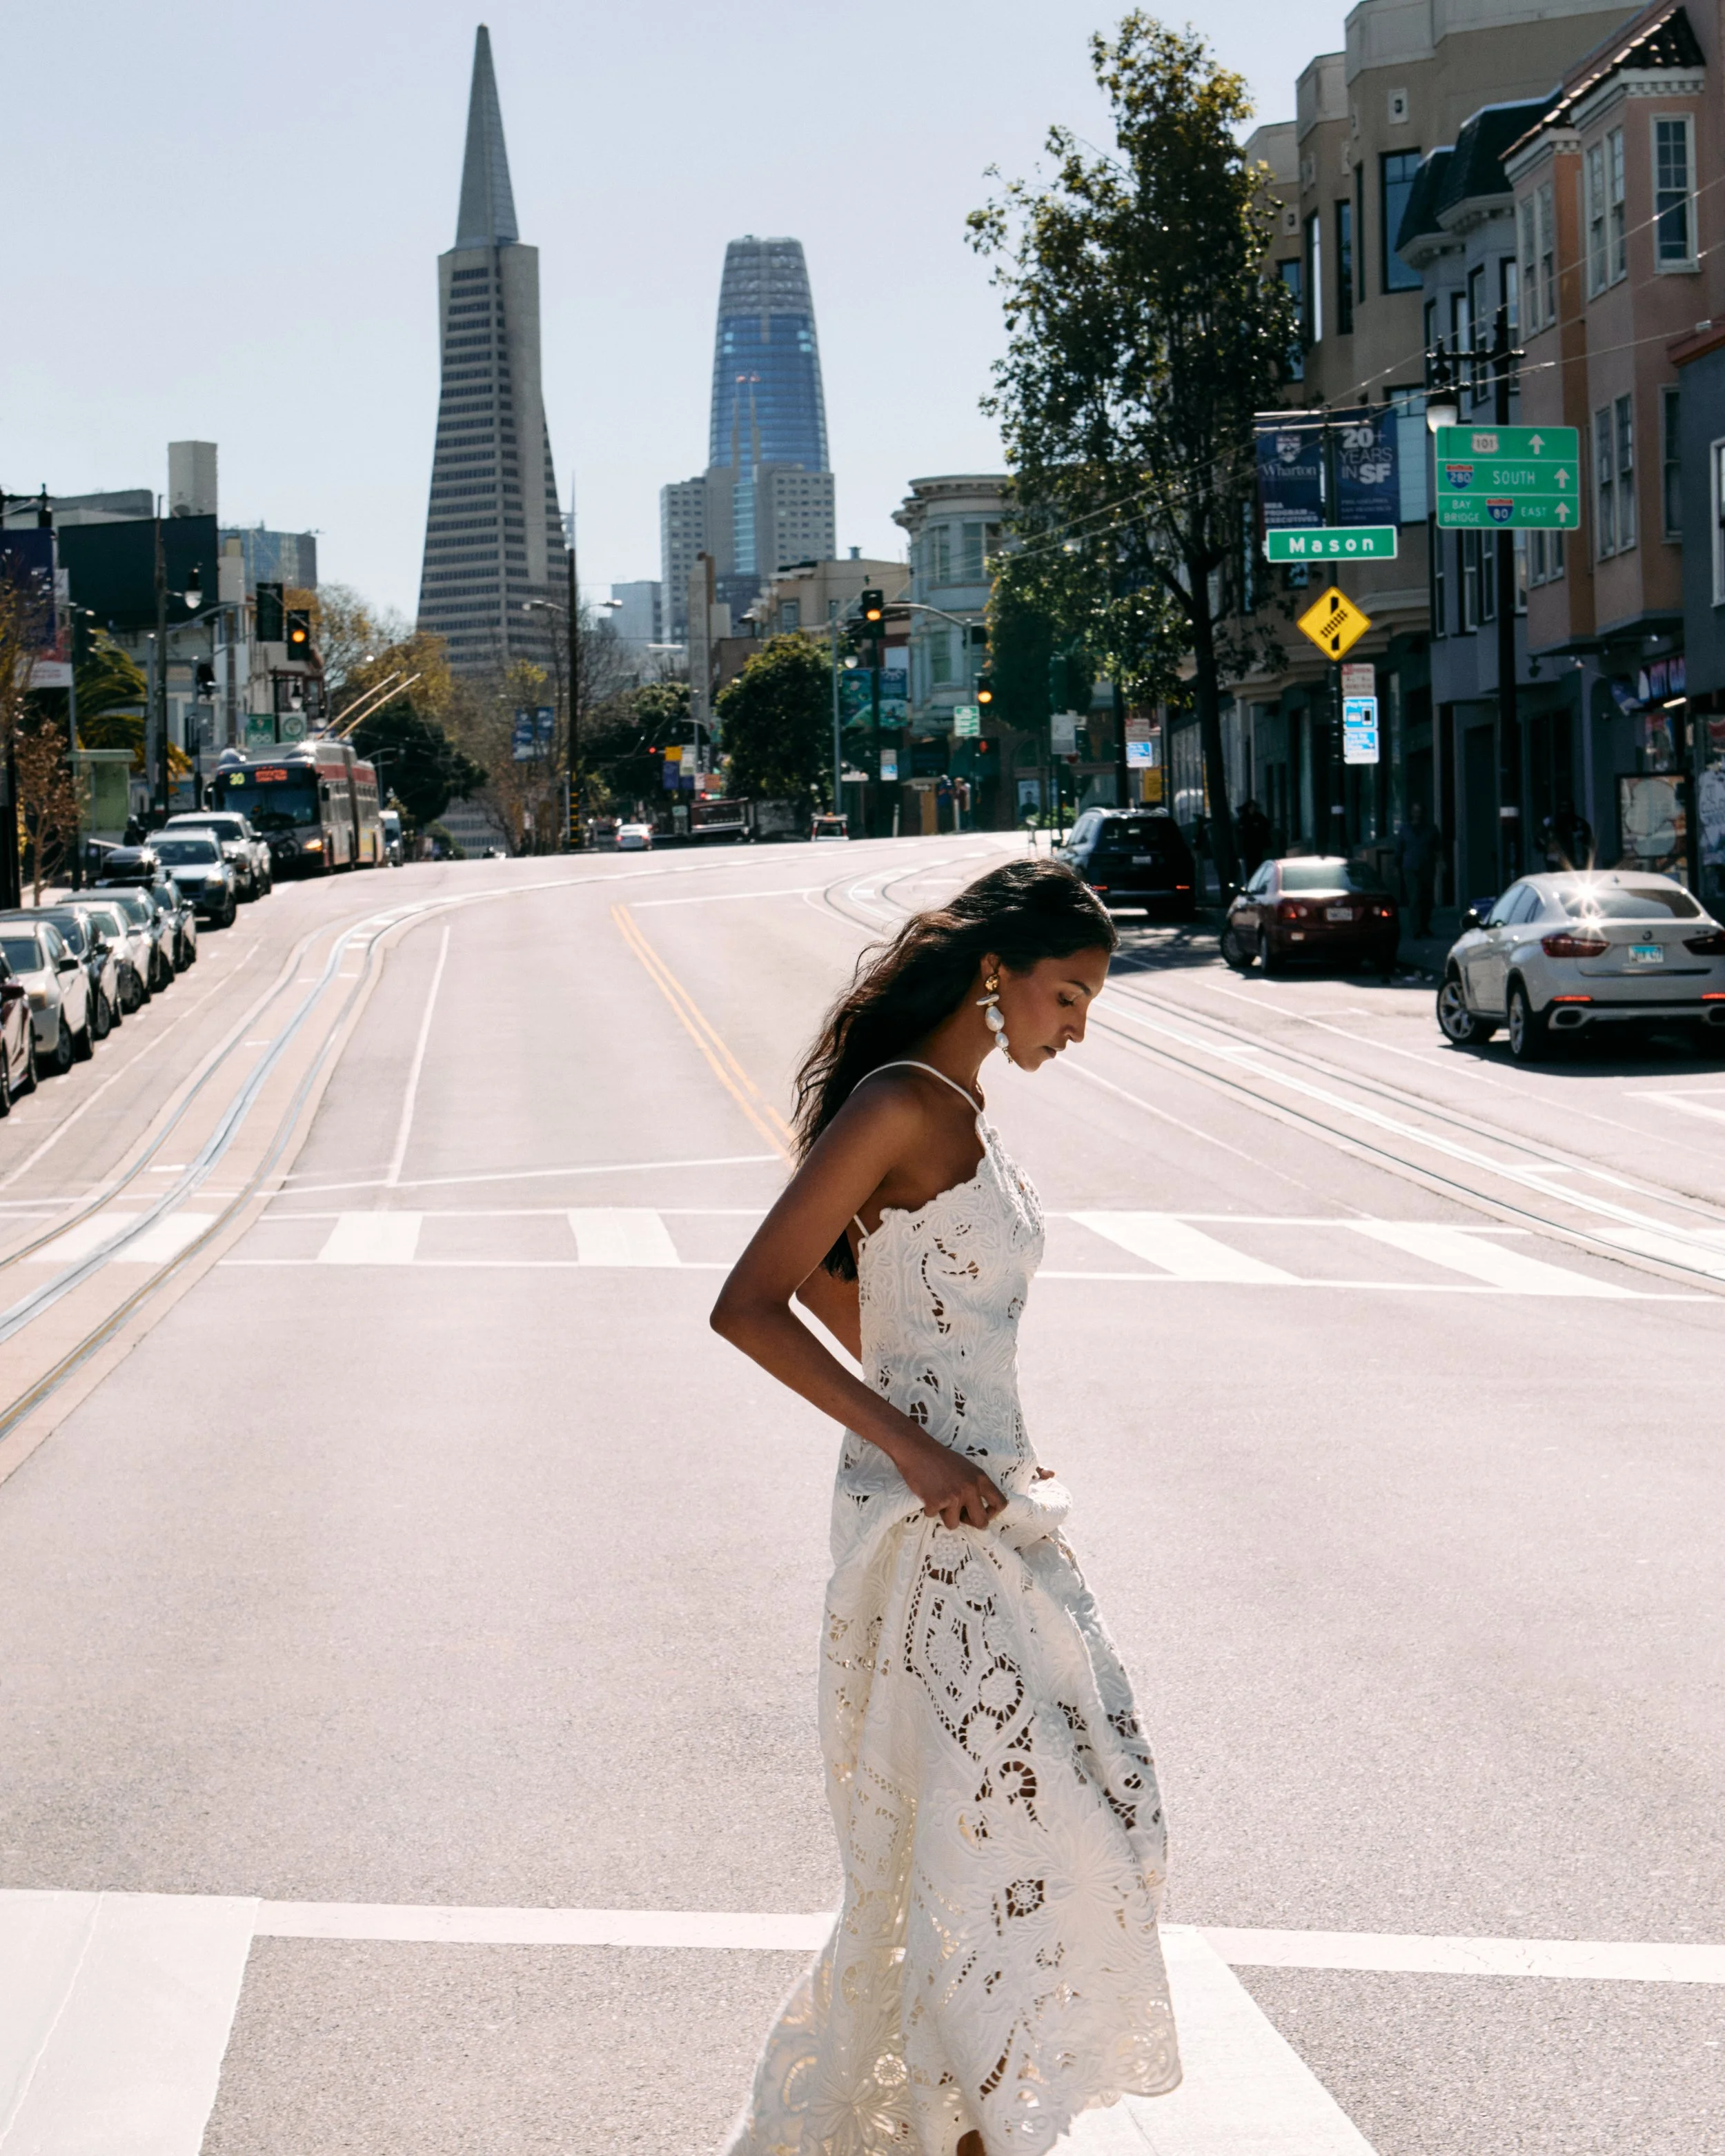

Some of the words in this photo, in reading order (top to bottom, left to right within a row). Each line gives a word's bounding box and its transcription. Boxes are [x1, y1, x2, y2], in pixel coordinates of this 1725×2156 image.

[1475, 438, 1495, 449] 101
[1339, 446, 1393, 464] YEARS
[1262, 463, 1317, 477] Wharton
[1341, 464, 1358, 479] IN
[1359, 463, 1391, 484] SF
[1450, 472, 1472, 484] 280
[1492, 471, 1535, 485] SOUTH
[1452, 499, 1471, 509] BAY
[1443, 512, 1479, 523] BRIDGE
[1492, 508, 1508, 520] 80
[1521, 506, 1546, 517] EAST
[1289, 537, 1374, 555] Mason
